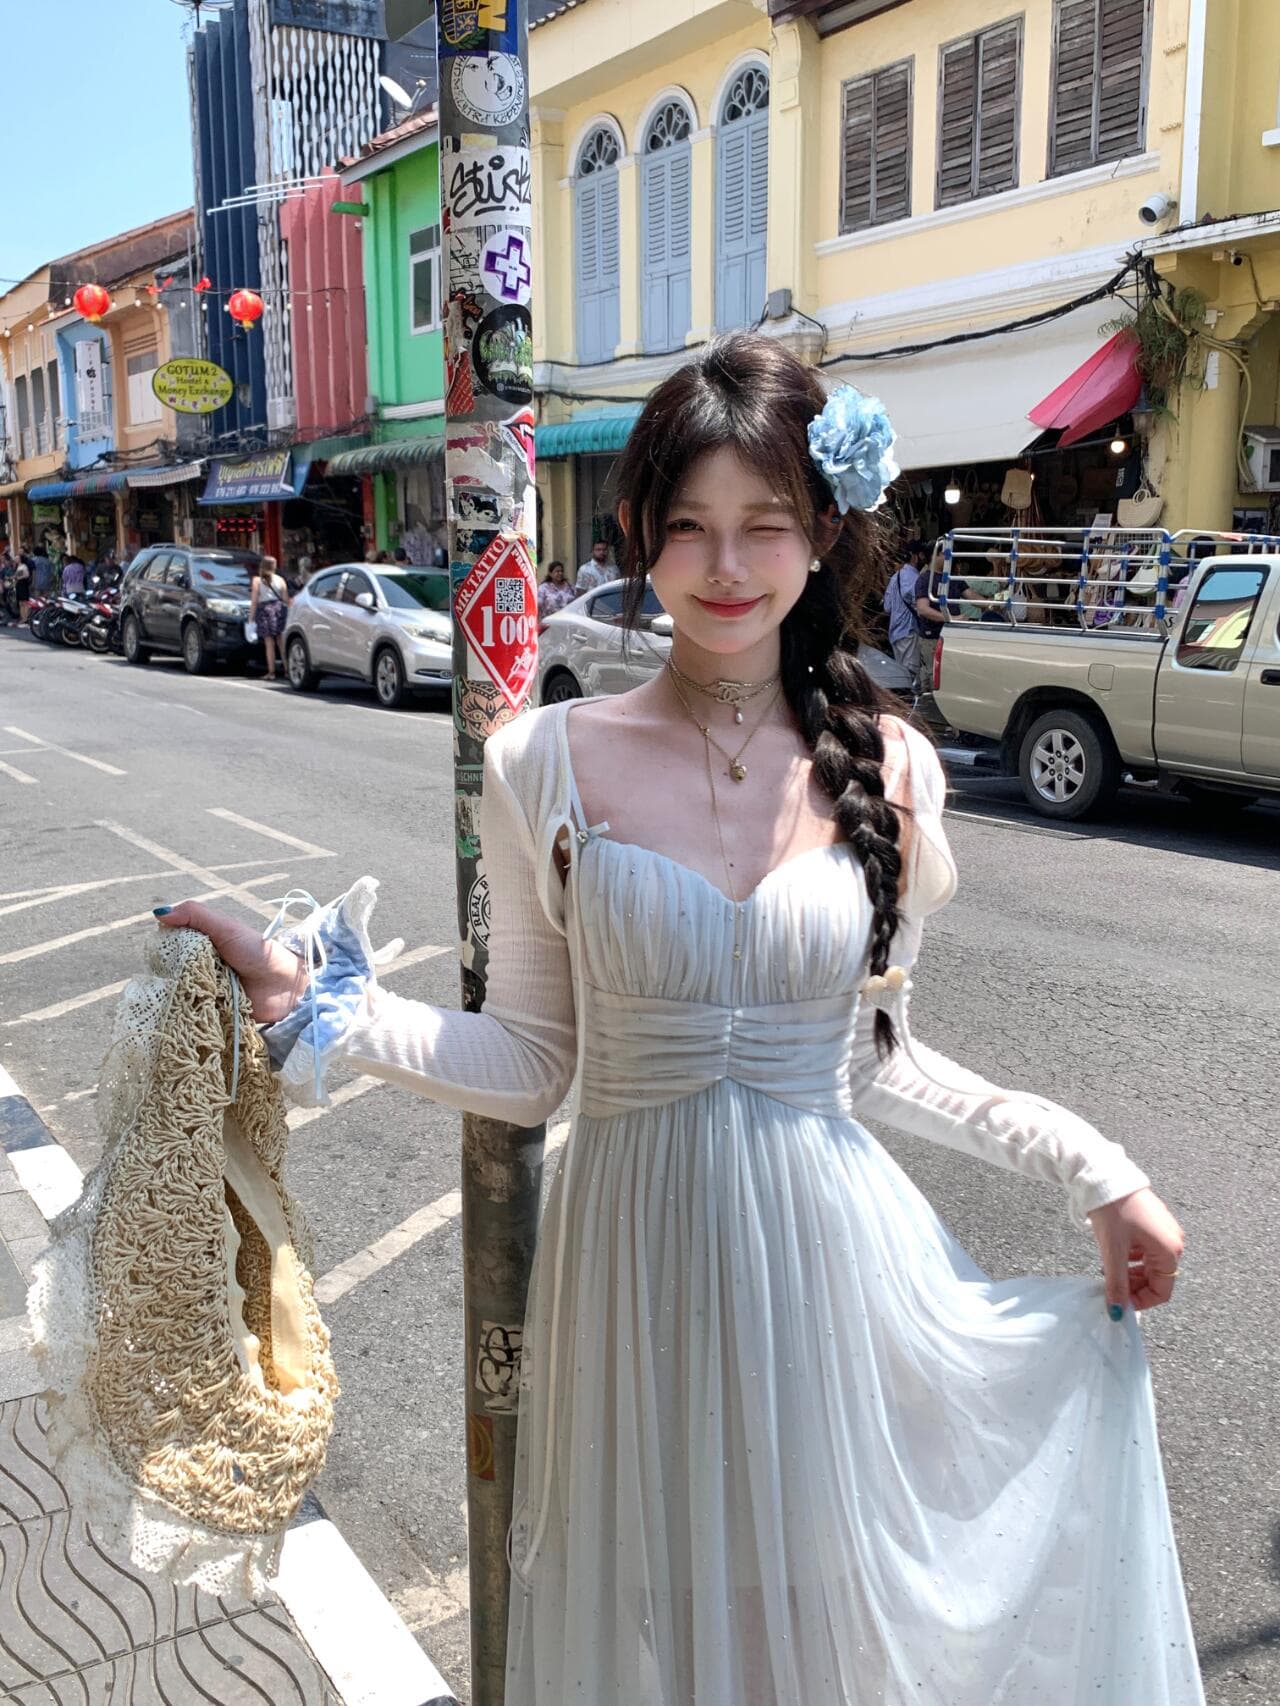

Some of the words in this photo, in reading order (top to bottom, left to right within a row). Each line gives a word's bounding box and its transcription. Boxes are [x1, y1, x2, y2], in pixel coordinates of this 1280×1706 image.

[158, 385, 188, 397] Money
[188, 385, 230, 398] Exchange
[471, 893, 482, 928] REAL
